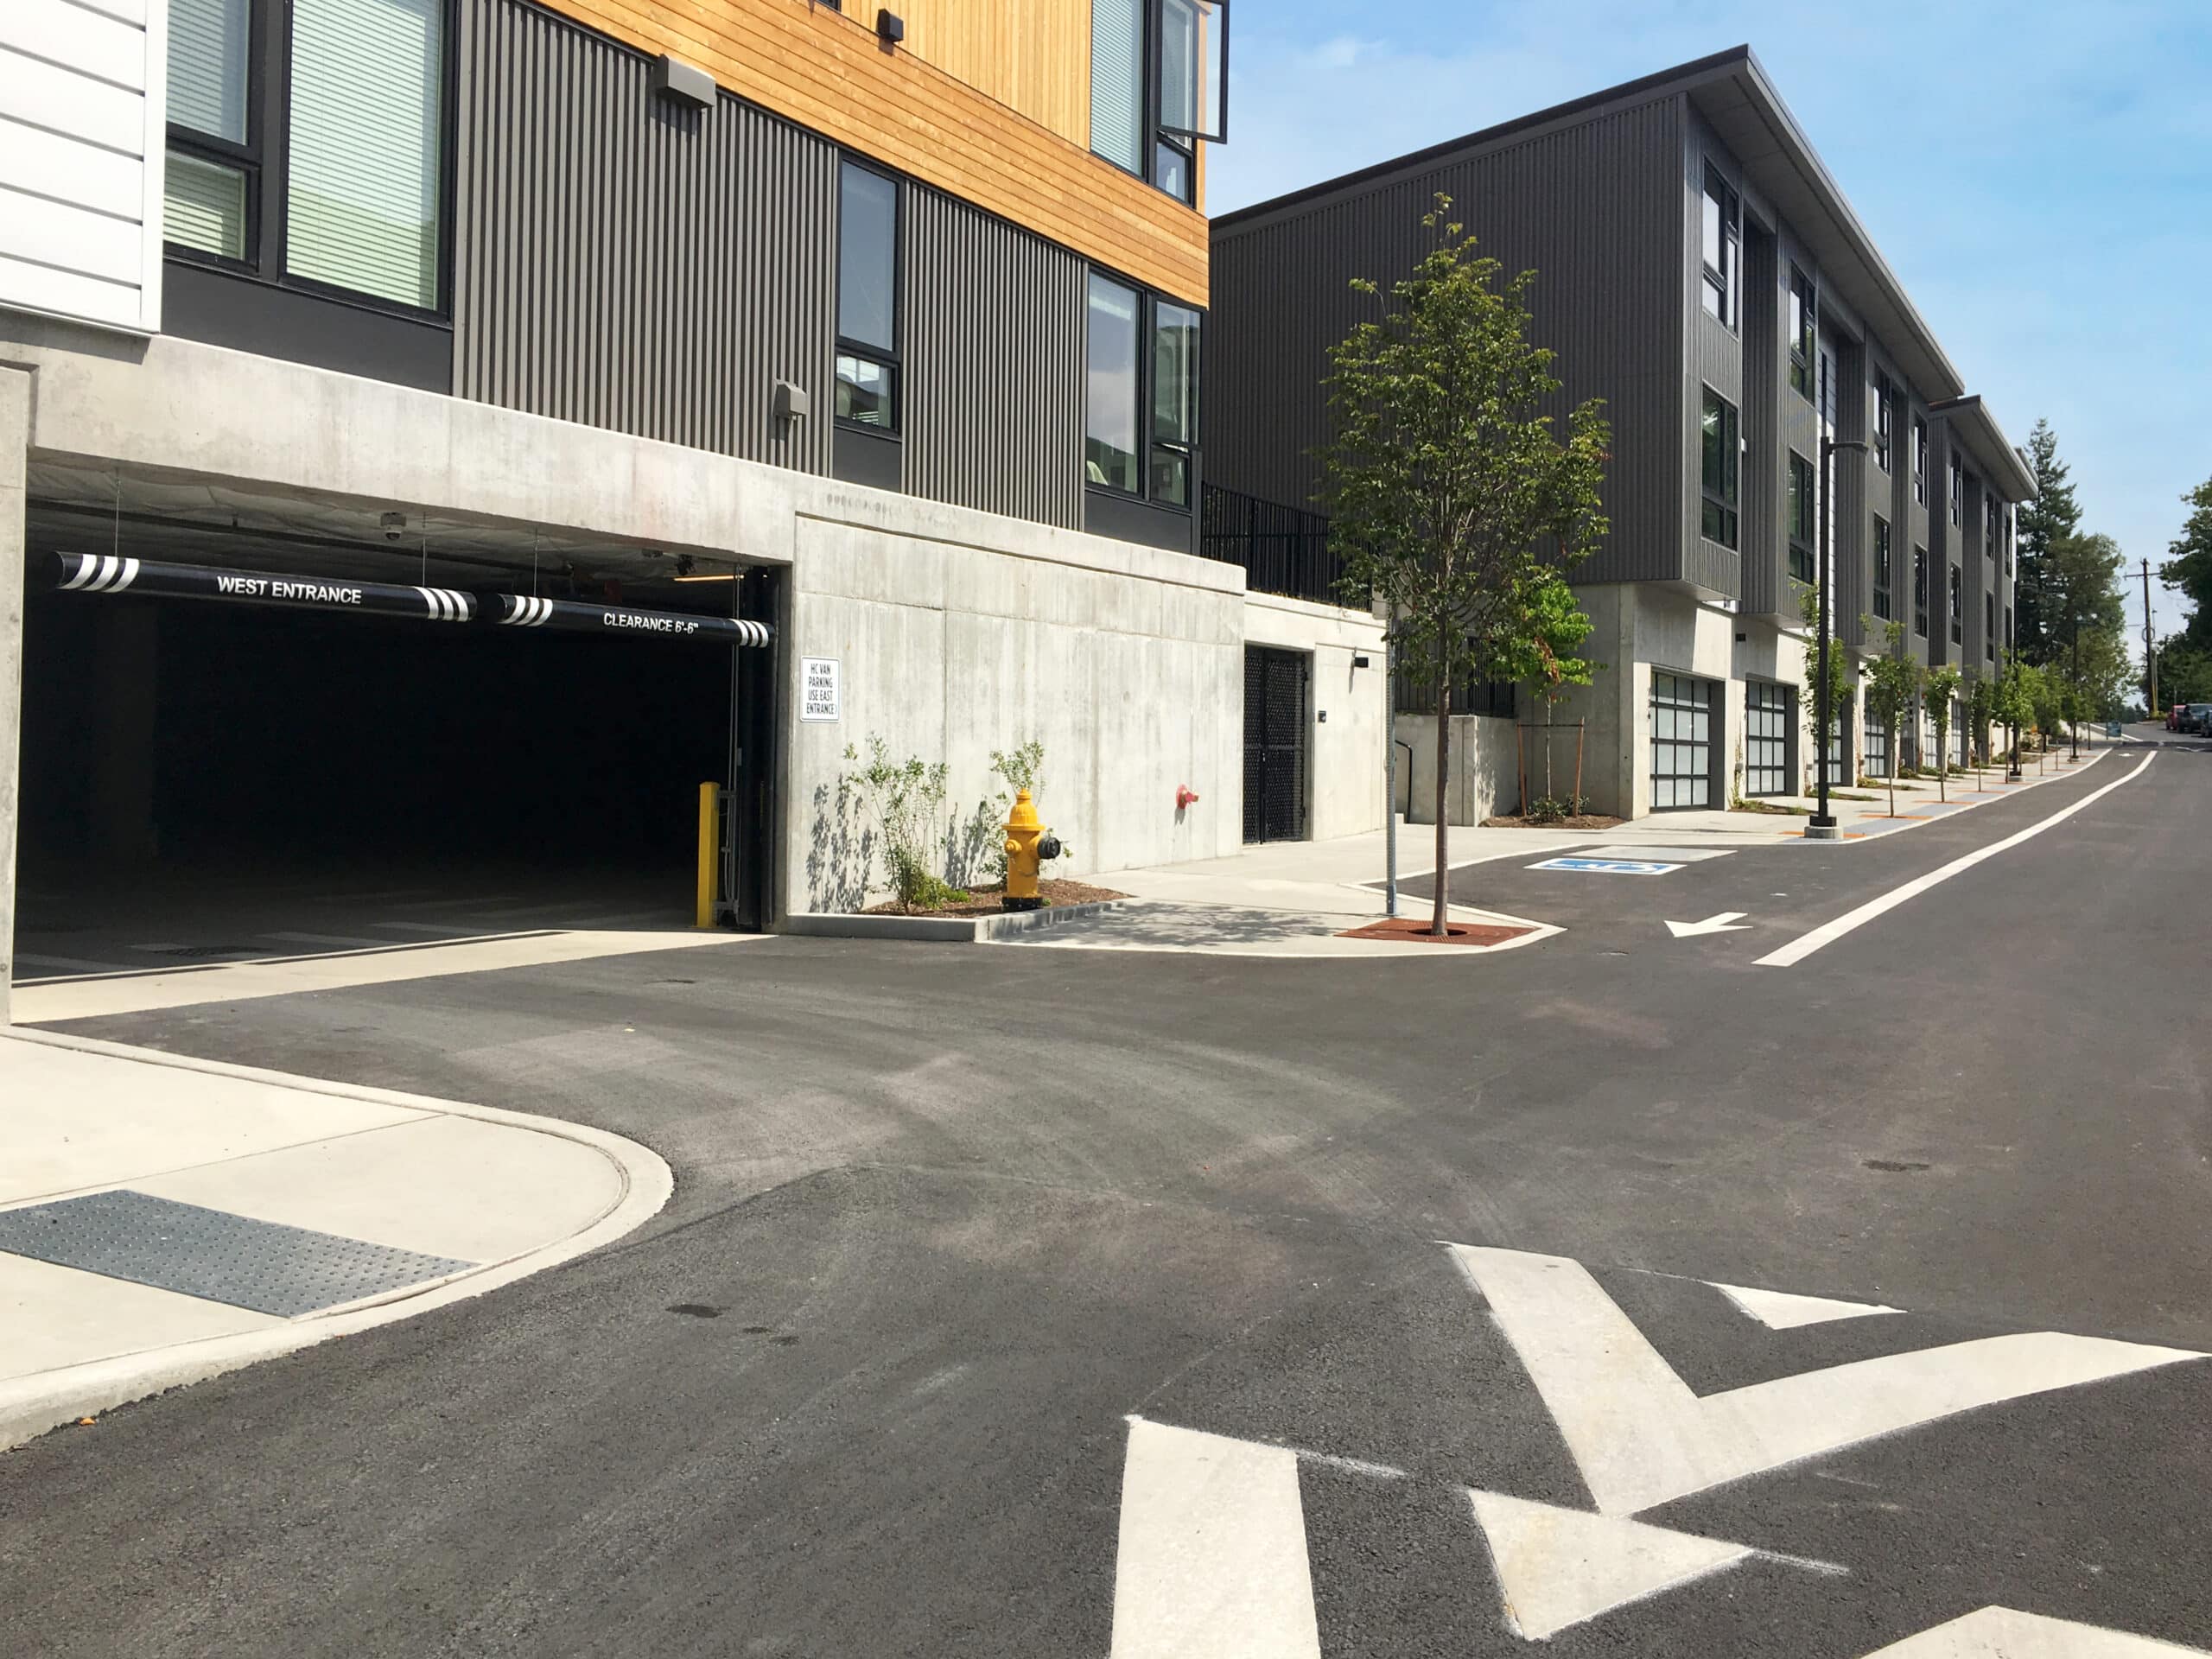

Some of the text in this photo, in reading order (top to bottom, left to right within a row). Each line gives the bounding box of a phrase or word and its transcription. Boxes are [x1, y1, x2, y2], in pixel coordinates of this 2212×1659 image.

[217, 575, 361, 603] WEST ENTRANCE
[603, 613, 673, 632] CLEARANCE
[810, 664, 830, 675] HC VAN
[808, 676, 833, 688] PARKING
[808, 690, 833, 702] USE EAST
[806, 702, 834, 715] ENTRANCE
